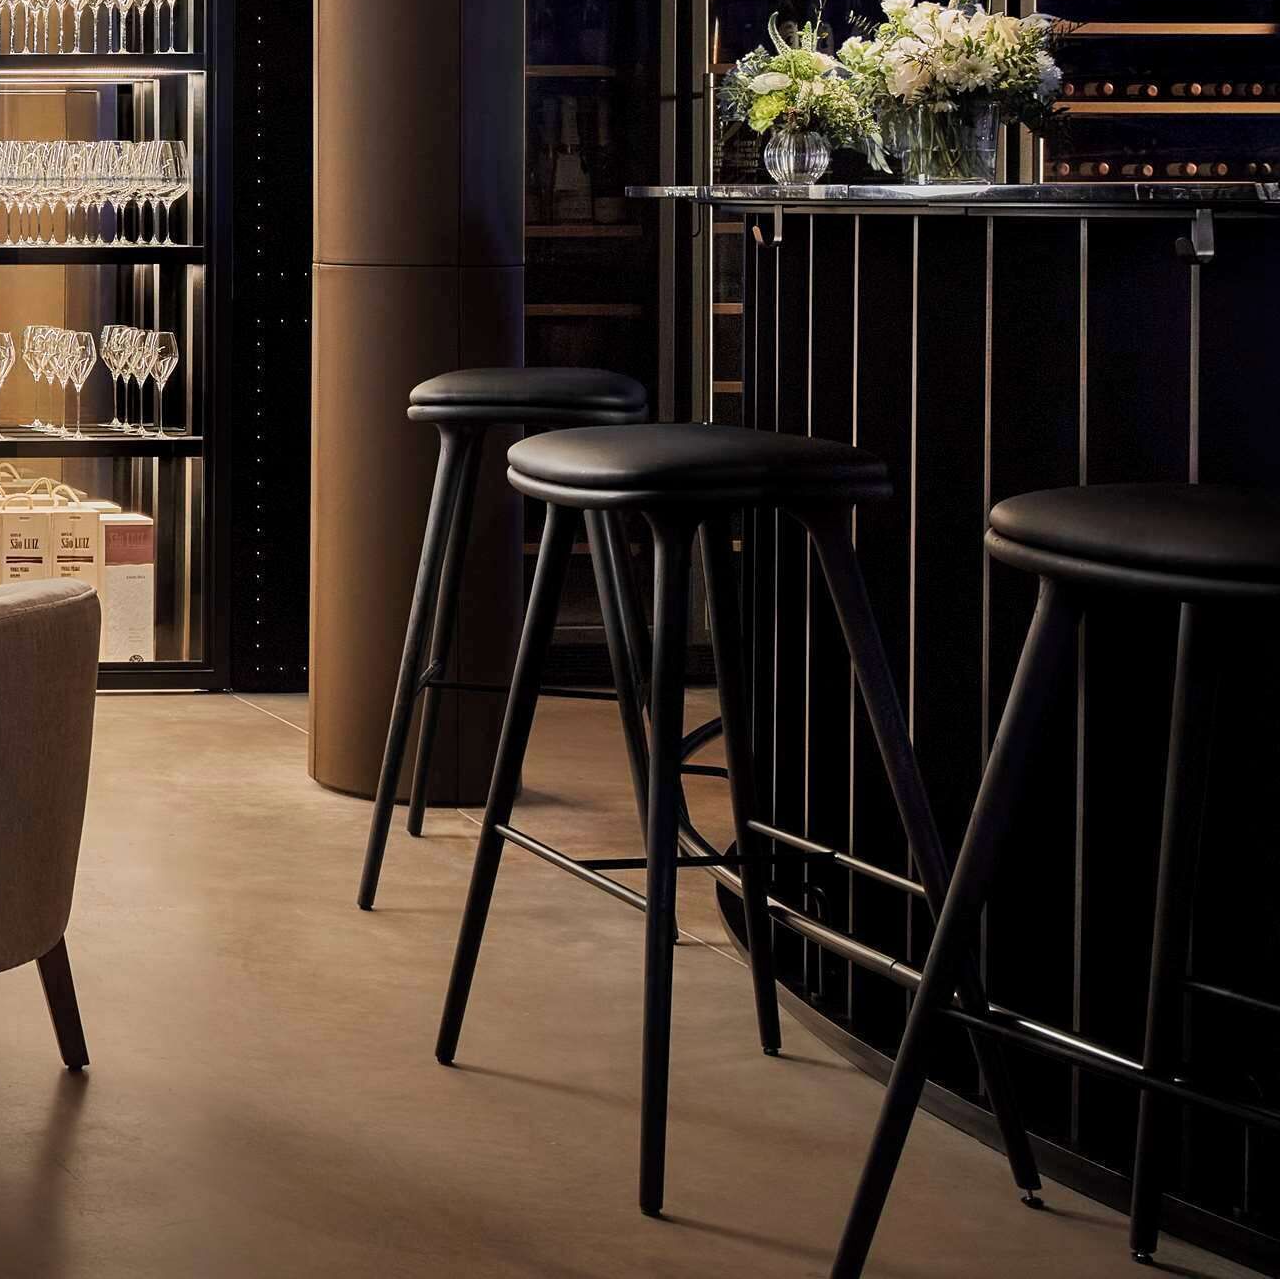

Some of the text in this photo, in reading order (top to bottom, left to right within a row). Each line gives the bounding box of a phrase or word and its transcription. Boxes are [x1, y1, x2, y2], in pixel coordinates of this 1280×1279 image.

[10, 538, 39, 550] São LUIZ
[61, 537, 91, 549] São LUIZ
